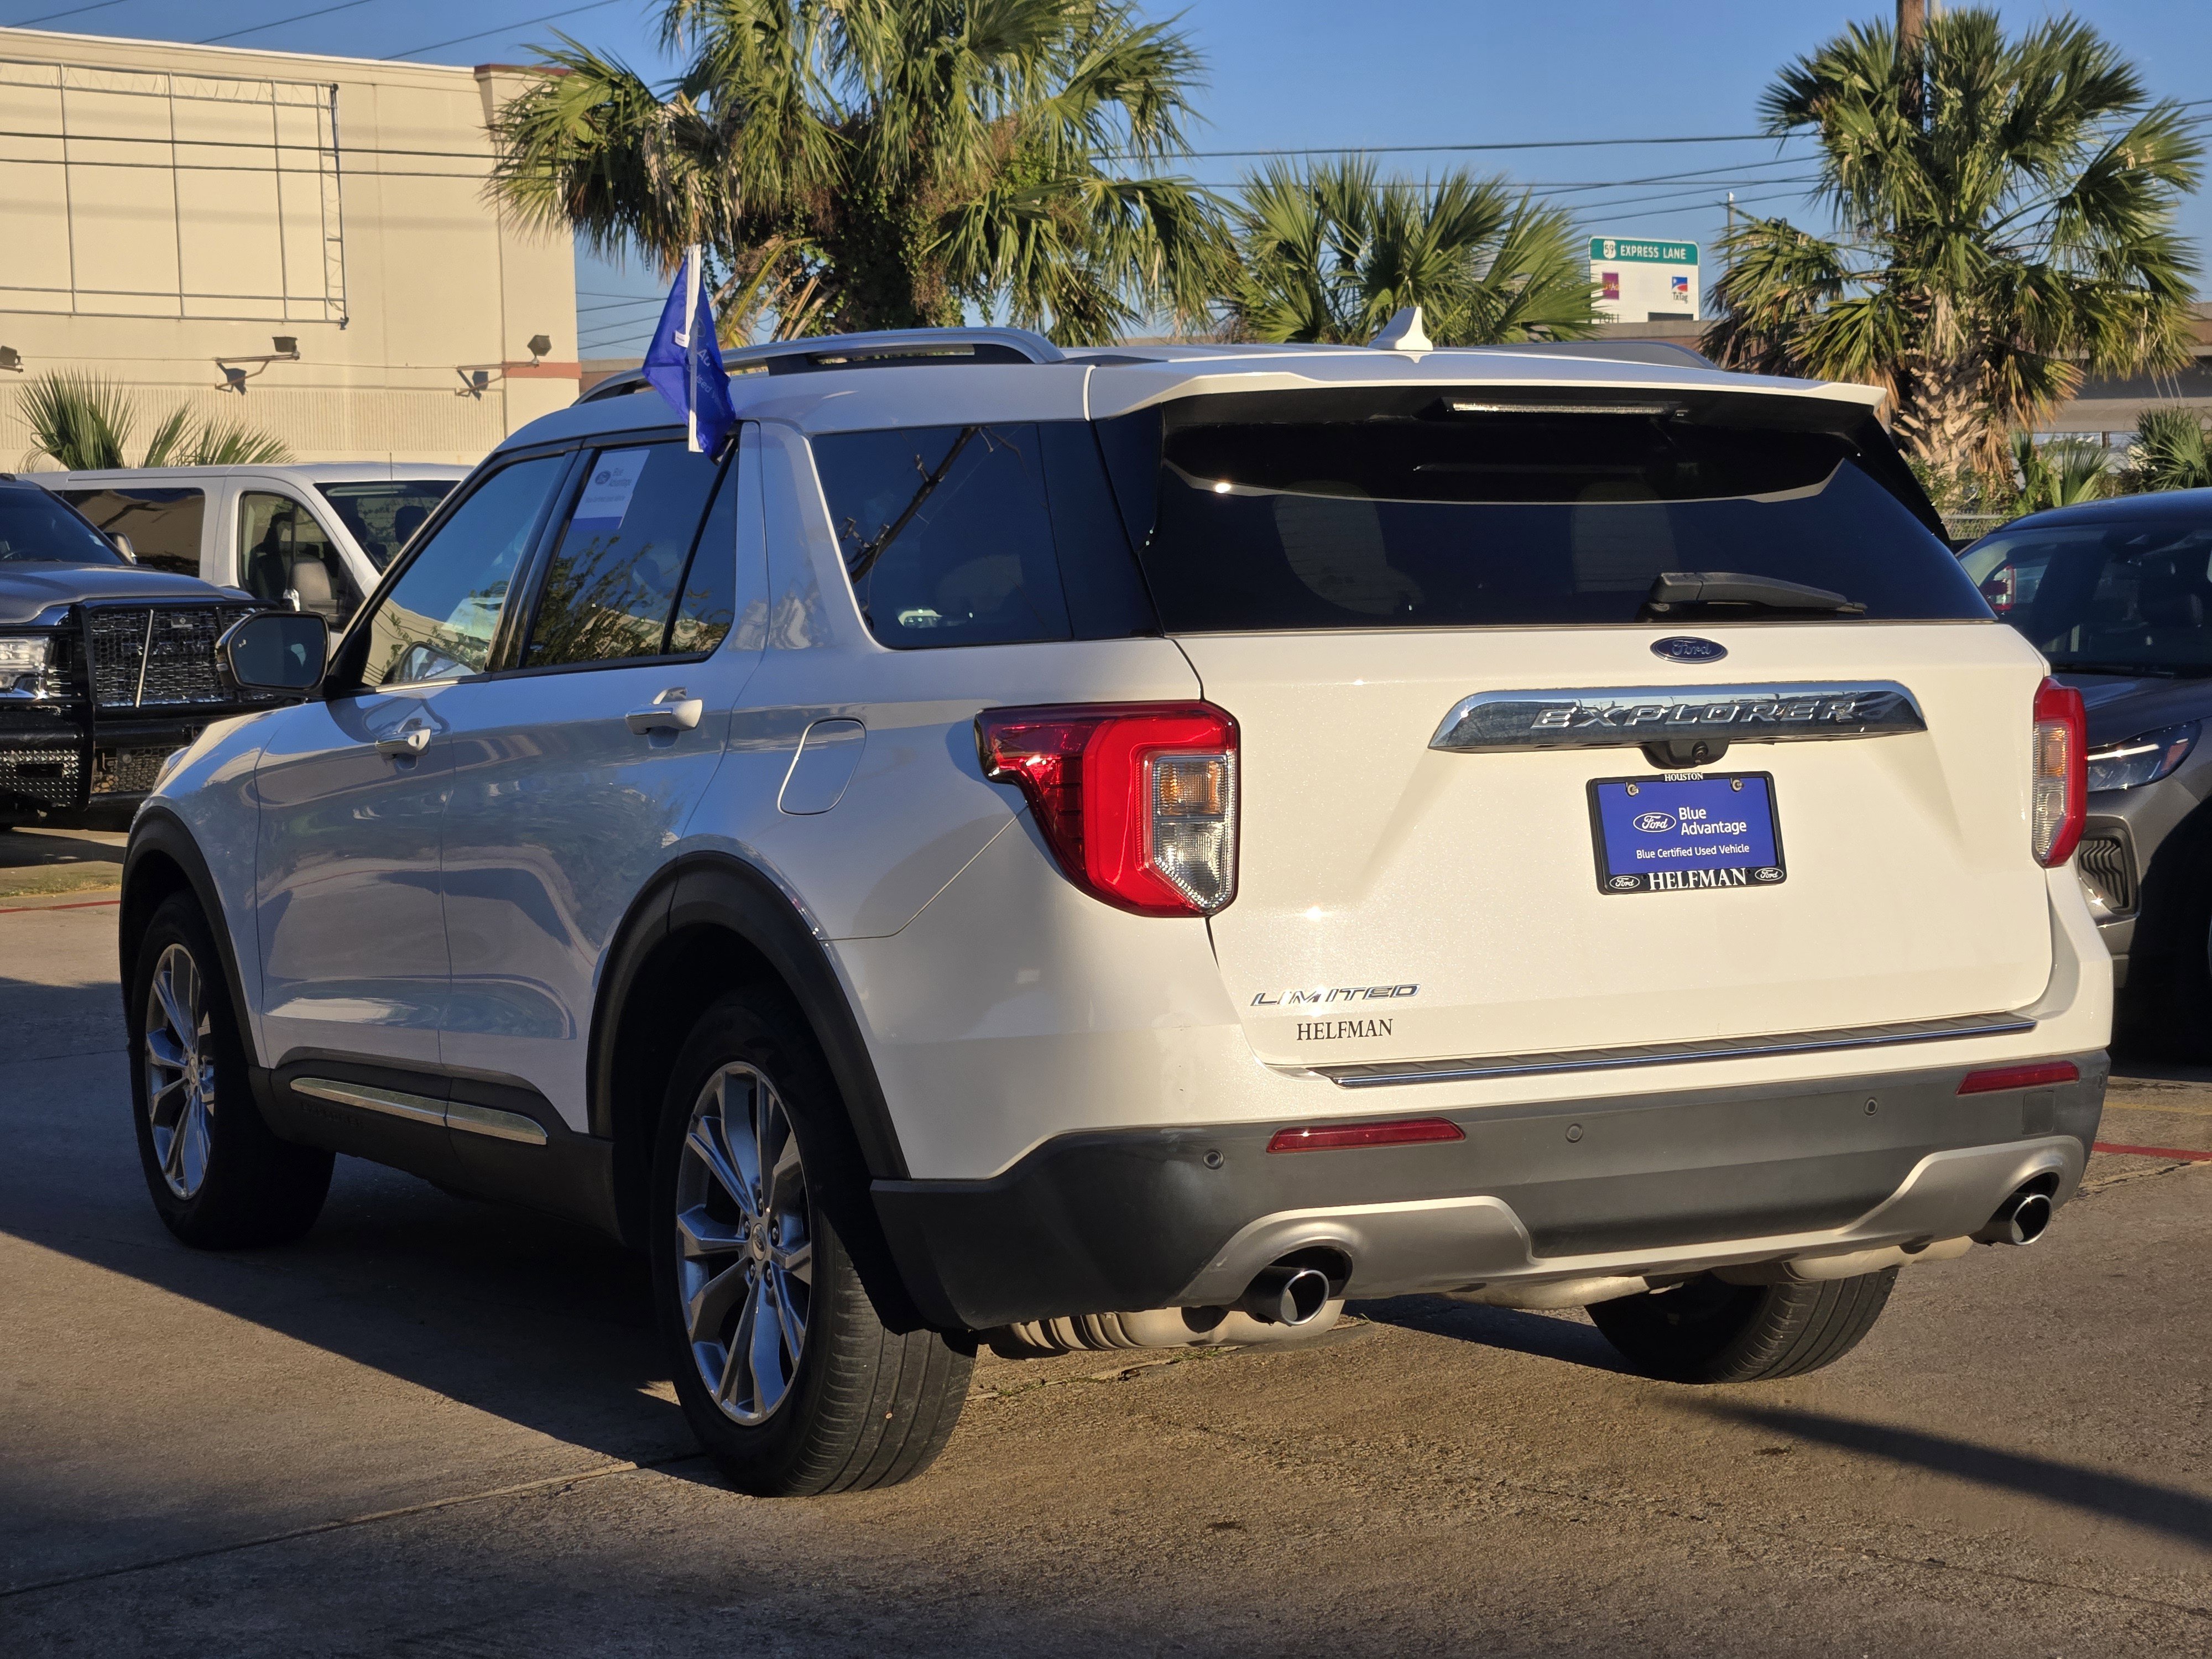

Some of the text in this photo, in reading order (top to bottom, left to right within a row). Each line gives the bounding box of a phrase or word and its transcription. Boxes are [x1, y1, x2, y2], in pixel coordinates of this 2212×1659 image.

[1604, 244, 1686, 259] 59 EXPRESS LANE
[1672, 291, 1688, 304] TxTag
[1672, 640, 1712, 655] Ford
[1530, 701, 1856, 729] EXPLORER
[1664, 773, 1703, 781] HOUSTON
[1678, 806, 1707, 820] Blue
[1641, 815, 1668, 830] Ford
[1681, 821, 1747, 836] Advantage
[1636, 843, 1750, 859] Blue Certified Used Vehicle
[1615, 868, 1779, 890] Ford HELFMAN Ford
[1250, 983, 1421, 1006] LIMITED
[1296, 1018, 1394, 1041] HELFMAN
